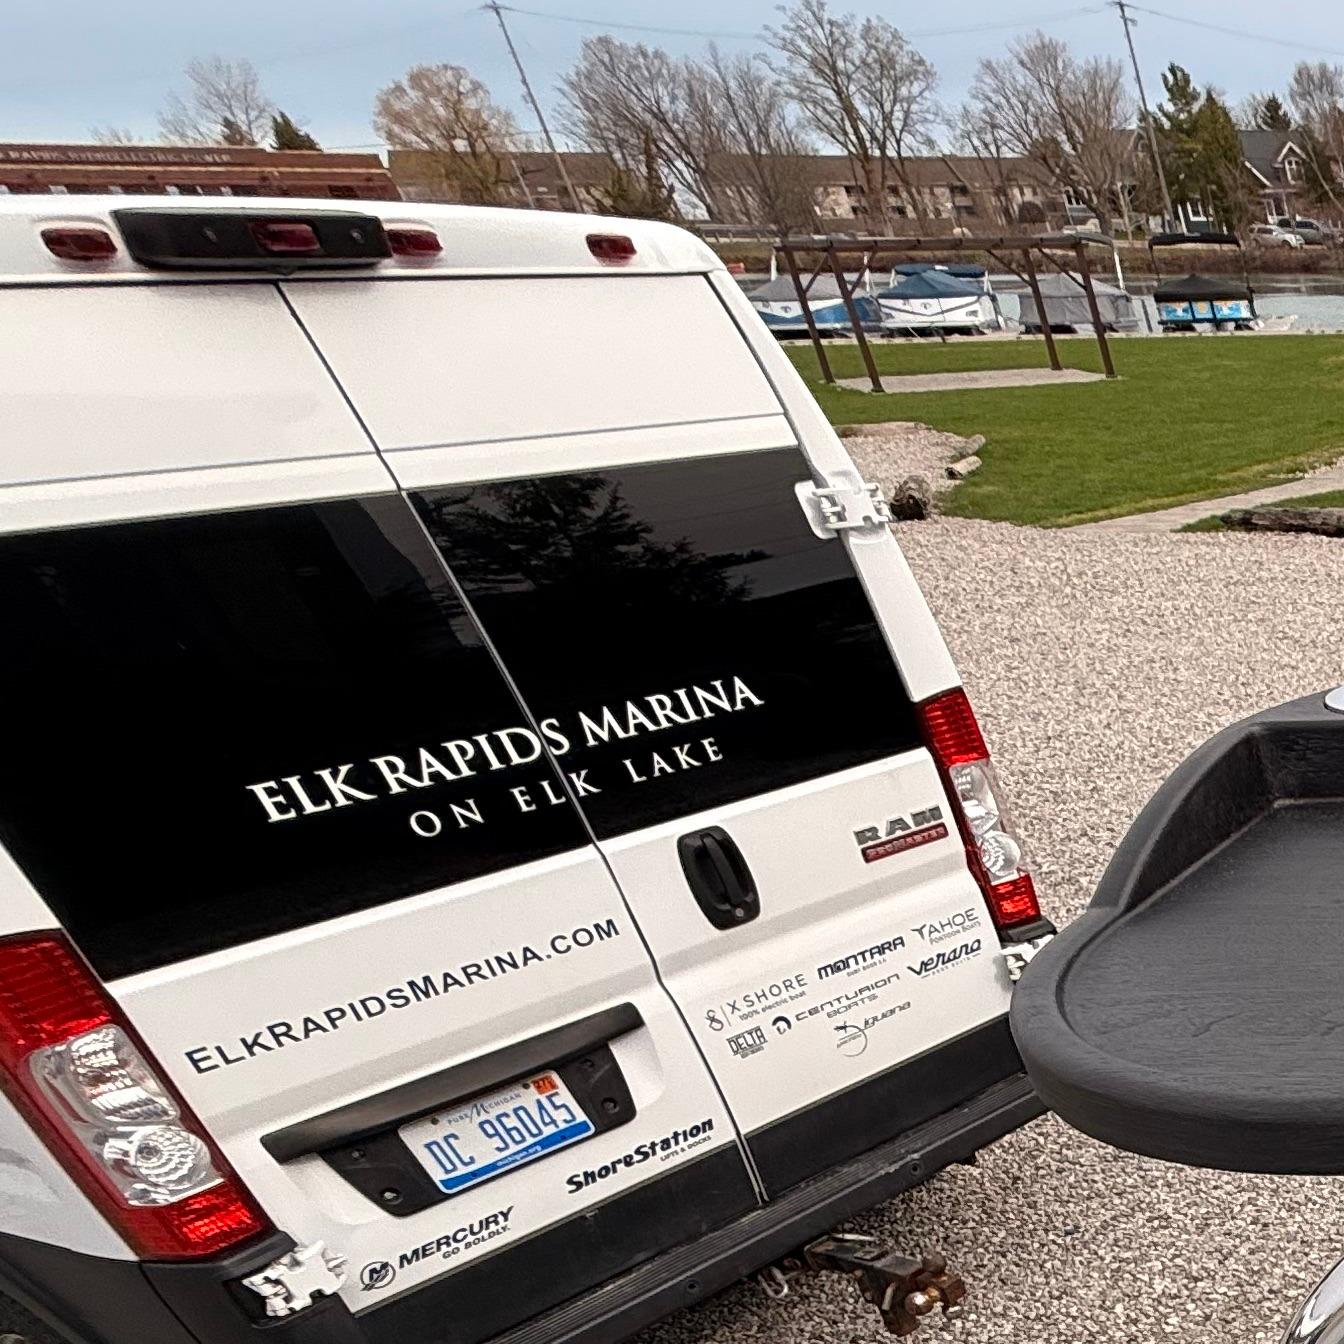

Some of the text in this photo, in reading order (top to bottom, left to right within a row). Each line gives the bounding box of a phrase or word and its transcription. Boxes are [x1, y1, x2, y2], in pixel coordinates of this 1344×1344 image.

[246, 675, 766, 824] ELK RAPIDS MARINA
[408, 736, 724, 838] ON ELK LAKE
[852, 804, 944, 847] RAM
[910, 907, 979, 941] TAHOE
[184, 917, 621, 1075] ELKRAPIDSMARINA.COM
[738, 1009, 761, 1022] 100%
[761, 998, 789, 1014] electric
[742, 973, 808, 1009] SHORE
[794, 973, 900, 1022] CENTURION
[826, 993, 879, 1018] BOATS
[726, 1026, 768, 1056] DELTA
[423, 1091, 577, 1175] DC 96045
[659, 1150, 679, 1162] LIFTS
[687, 1134, 713, 1150] DOCKS
[565, 1117, 714, 1195] ShoreStation
[397, 1205, 515, 1270] MERCURY
[442, 1224, 512, 1260] GO BOLDLY.
